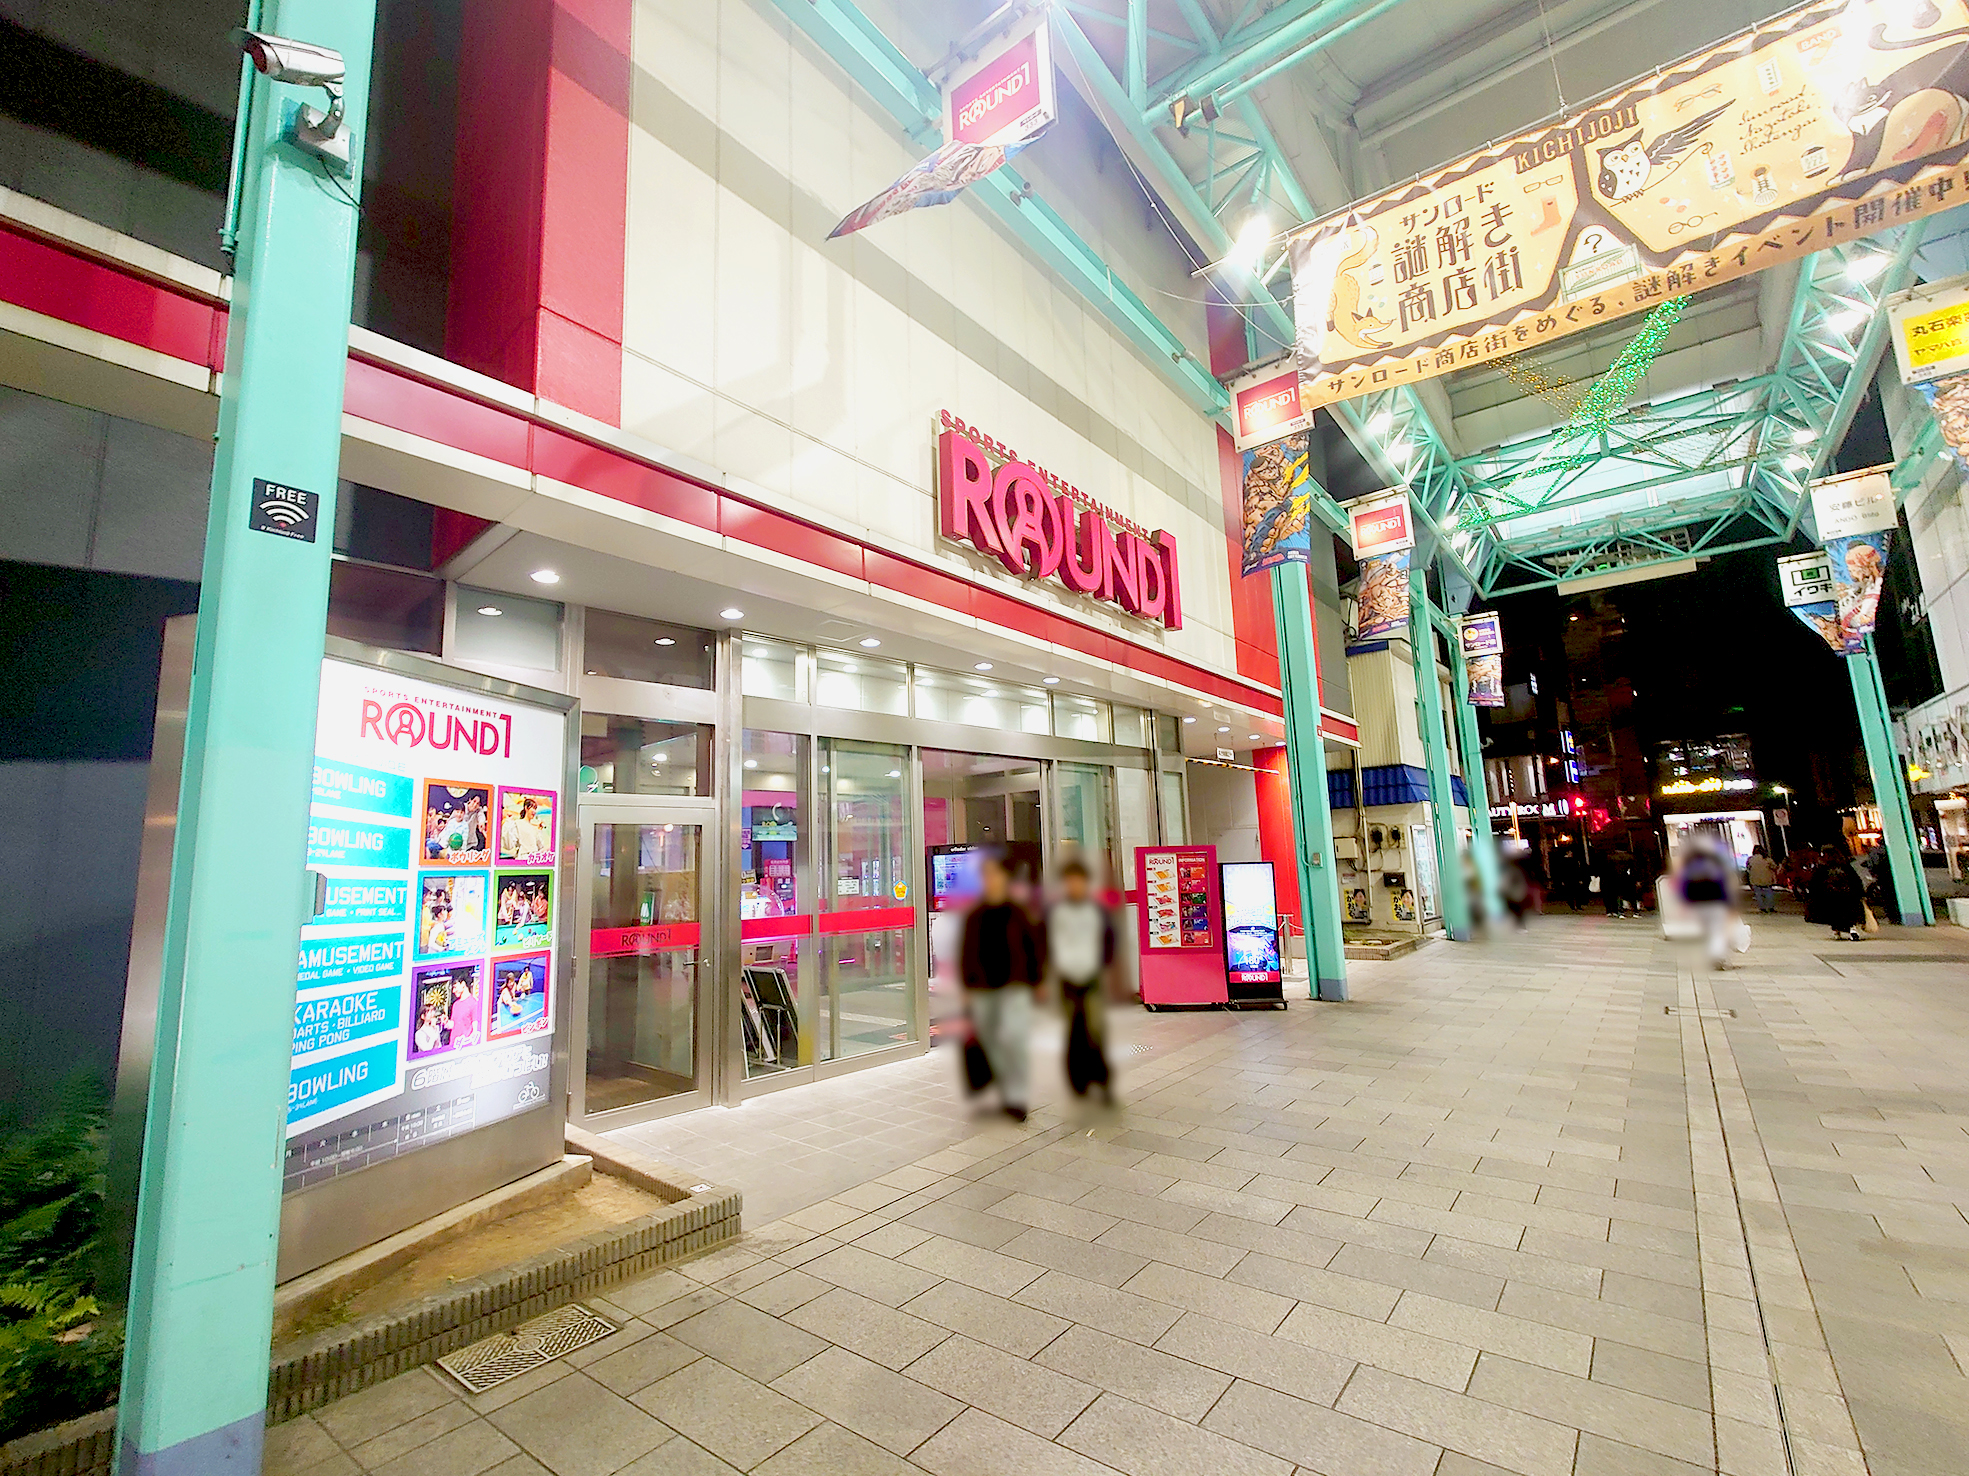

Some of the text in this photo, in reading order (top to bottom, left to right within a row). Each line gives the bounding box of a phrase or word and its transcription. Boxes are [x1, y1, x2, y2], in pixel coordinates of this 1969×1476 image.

[1801, 29, 1838, 50] BAND
[1517, 106, 1637, 171] KICHIJOJI
[1400, 181, 1495, 234] サンロード
[1391, 202, 1514, 284] 謎解き
[1397, 246, 1524, 333] 商店街
[1911, 312, 1969, 337] 丸石楽
[1243, 386, 1296, 420] ROUND1
[941, 408, 1150, 541] SPORTS ENTERTAINMENT
[265, 483, 308, 505] FREE
[939, 429, 1183, 631] ROUND1
[1793, 583, 1833, 597] イワキ
[364, 686, 498, 719] SPORTS ENTERTAINMENT
[360, 699, 512, 759] ROUND1
[450, 849, 491, 864] ボウリング
[527, 851, 555, 864] カラオケ
[325, 886, 408, 905] USEMENT
[326, 908, 348, 918] GAME
[355, 908, 378, 917] PRINT
[621, 928, 671, 947] ROUND1
[298, 941, 404, 969] AMUSEMENT
[297, 961, 395, 981] EDAL GAME VIDEO GAME
[294, 990, 379, 1025] KARAOKE
[337, 1008, 386, 1030] BILLIARD
[318, 1028, 351, 1048] PONG
